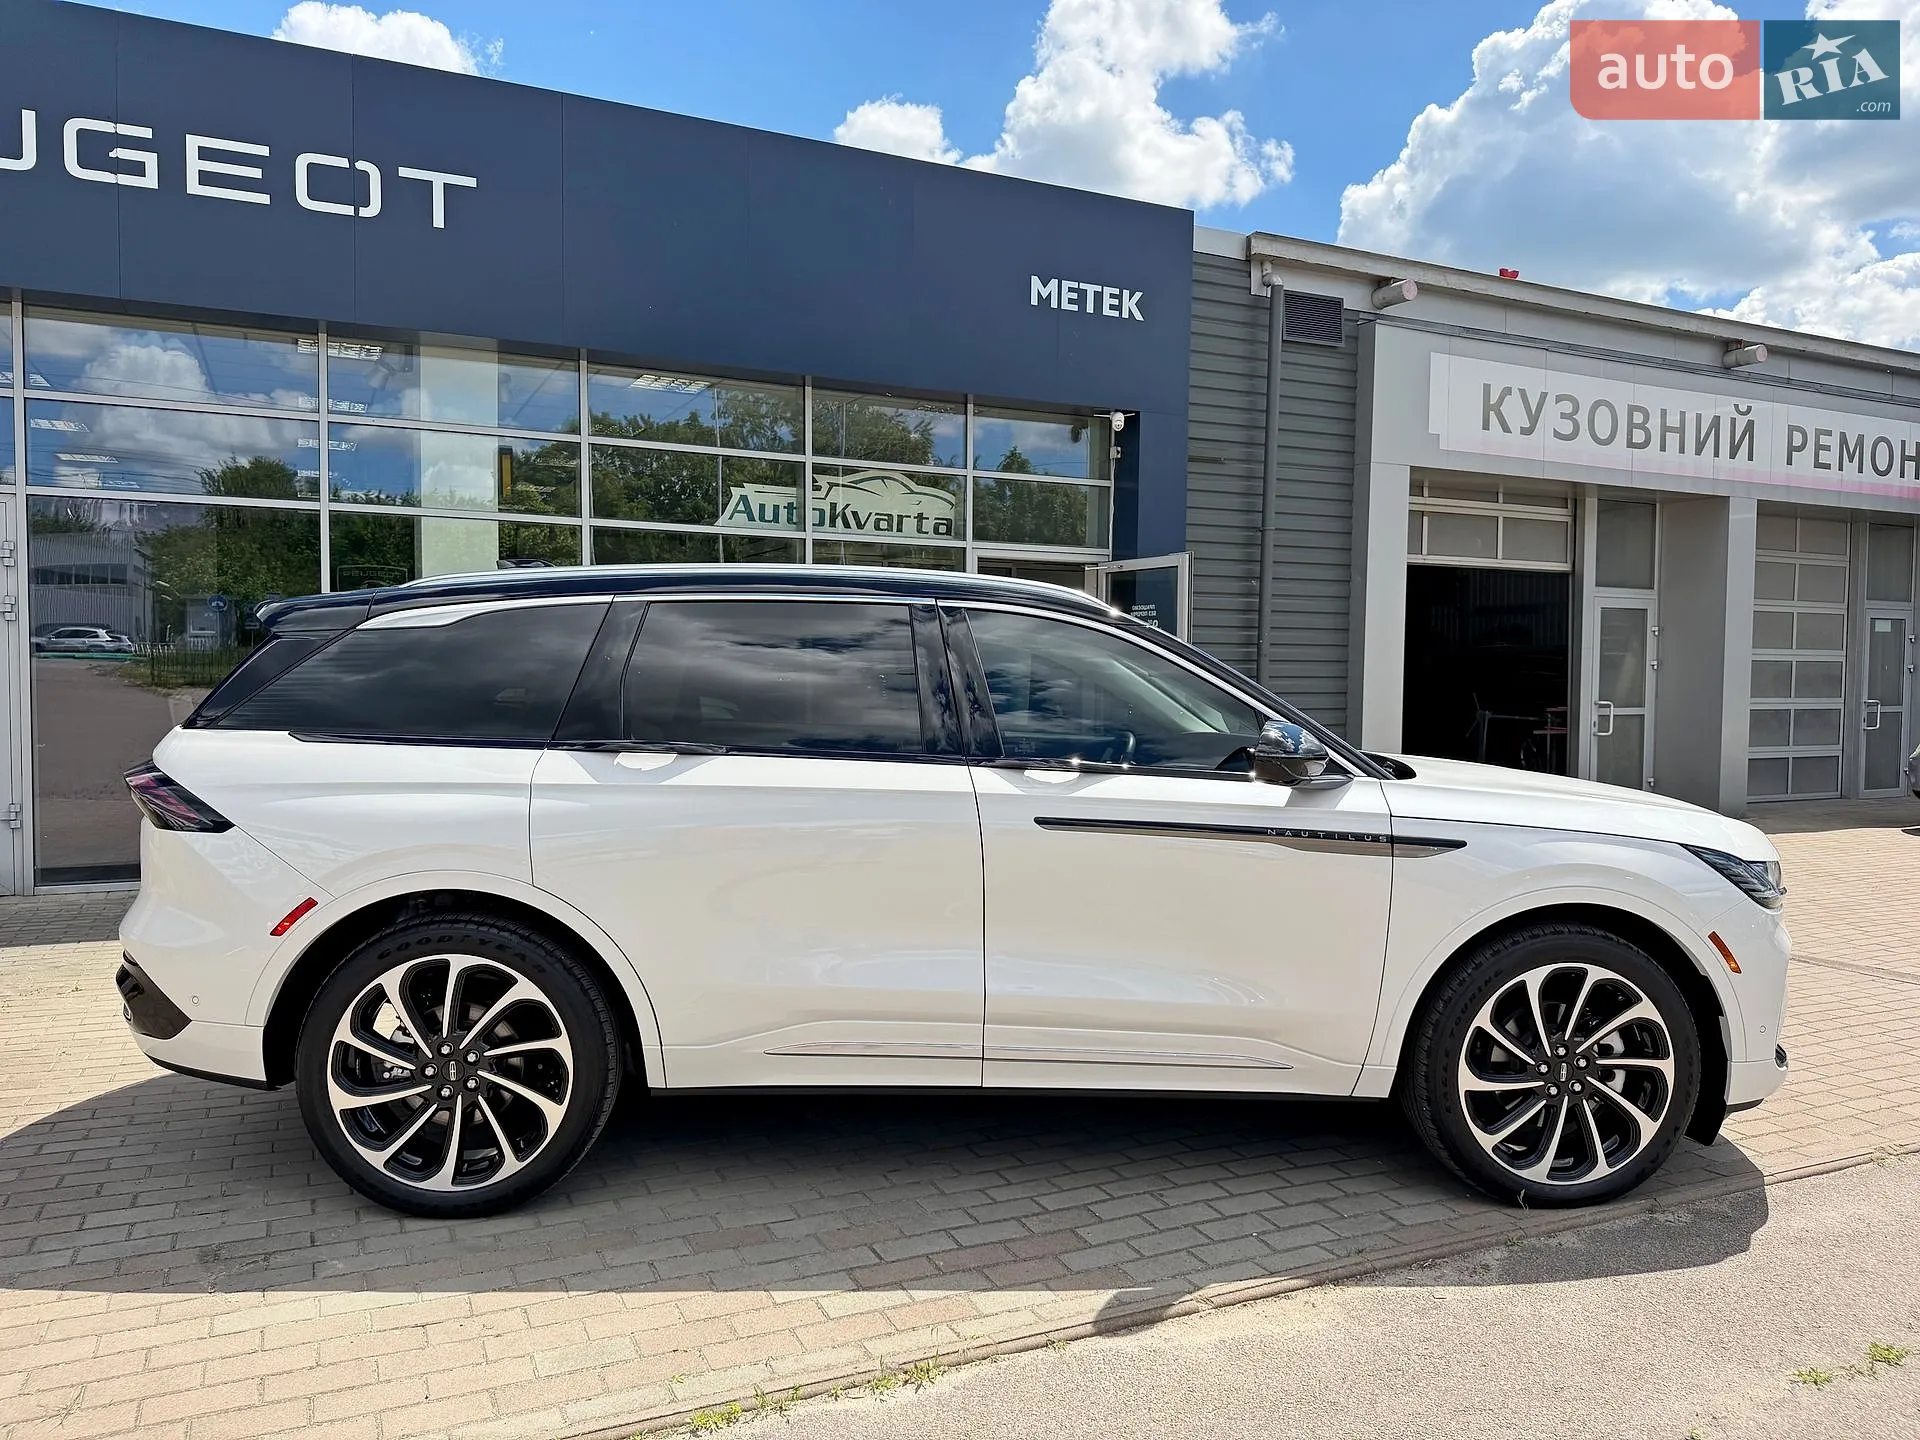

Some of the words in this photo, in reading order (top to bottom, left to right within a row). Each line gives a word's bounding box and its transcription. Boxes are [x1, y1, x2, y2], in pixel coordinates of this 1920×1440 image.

[1030, 275, 1144, 321] METEK
[1481, 382, 1755, 462] КУЗОВНИЙ
[727, 494, 953, 537] AutoKvarta
[1267, 829, 1387, 842] NAUTILUS
